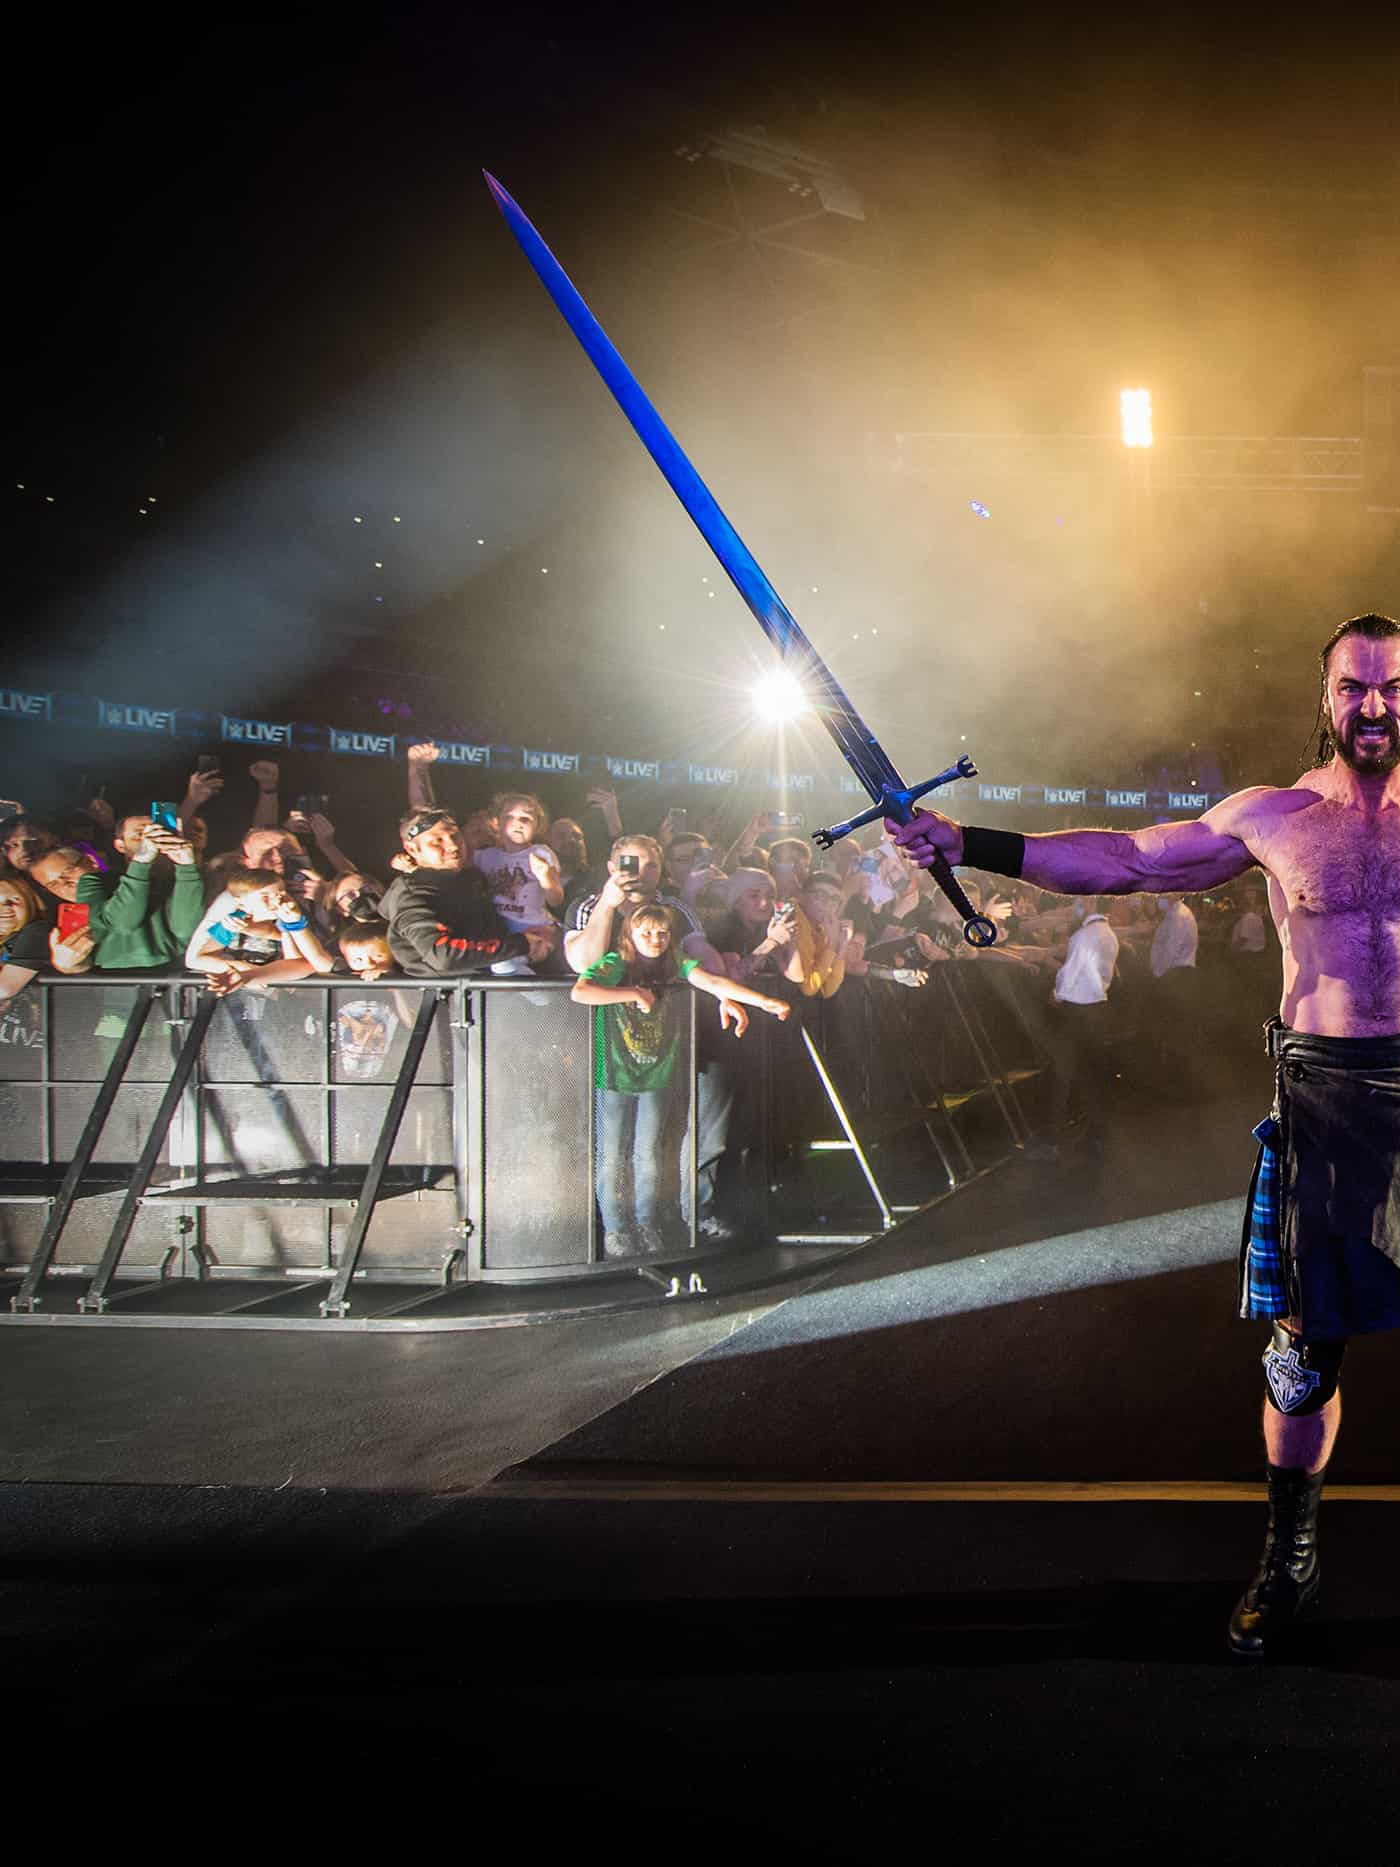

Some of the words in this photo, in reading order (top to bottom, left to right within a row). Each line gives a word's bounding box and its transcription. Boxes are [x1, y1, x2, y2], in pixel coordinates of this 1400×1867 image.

[125, 706, 170, 729] LIVE
[248, 720, 287, 741] LIVE
[352, 735, 390, 752] LIVE
[452, 744, 487, 762] LIVE
[543, 755, 576, 770] LIVE
[625, 762, 655, 777] LIVE
[706, 769, 735, 783] LIVE
[992, 786, 1018, 800] LIVE
[1057, 791, 1082, 803] LIVE
[1119, 794, 1143, 805] LIVE
[1181, 795, 1207, 806] LIVE
